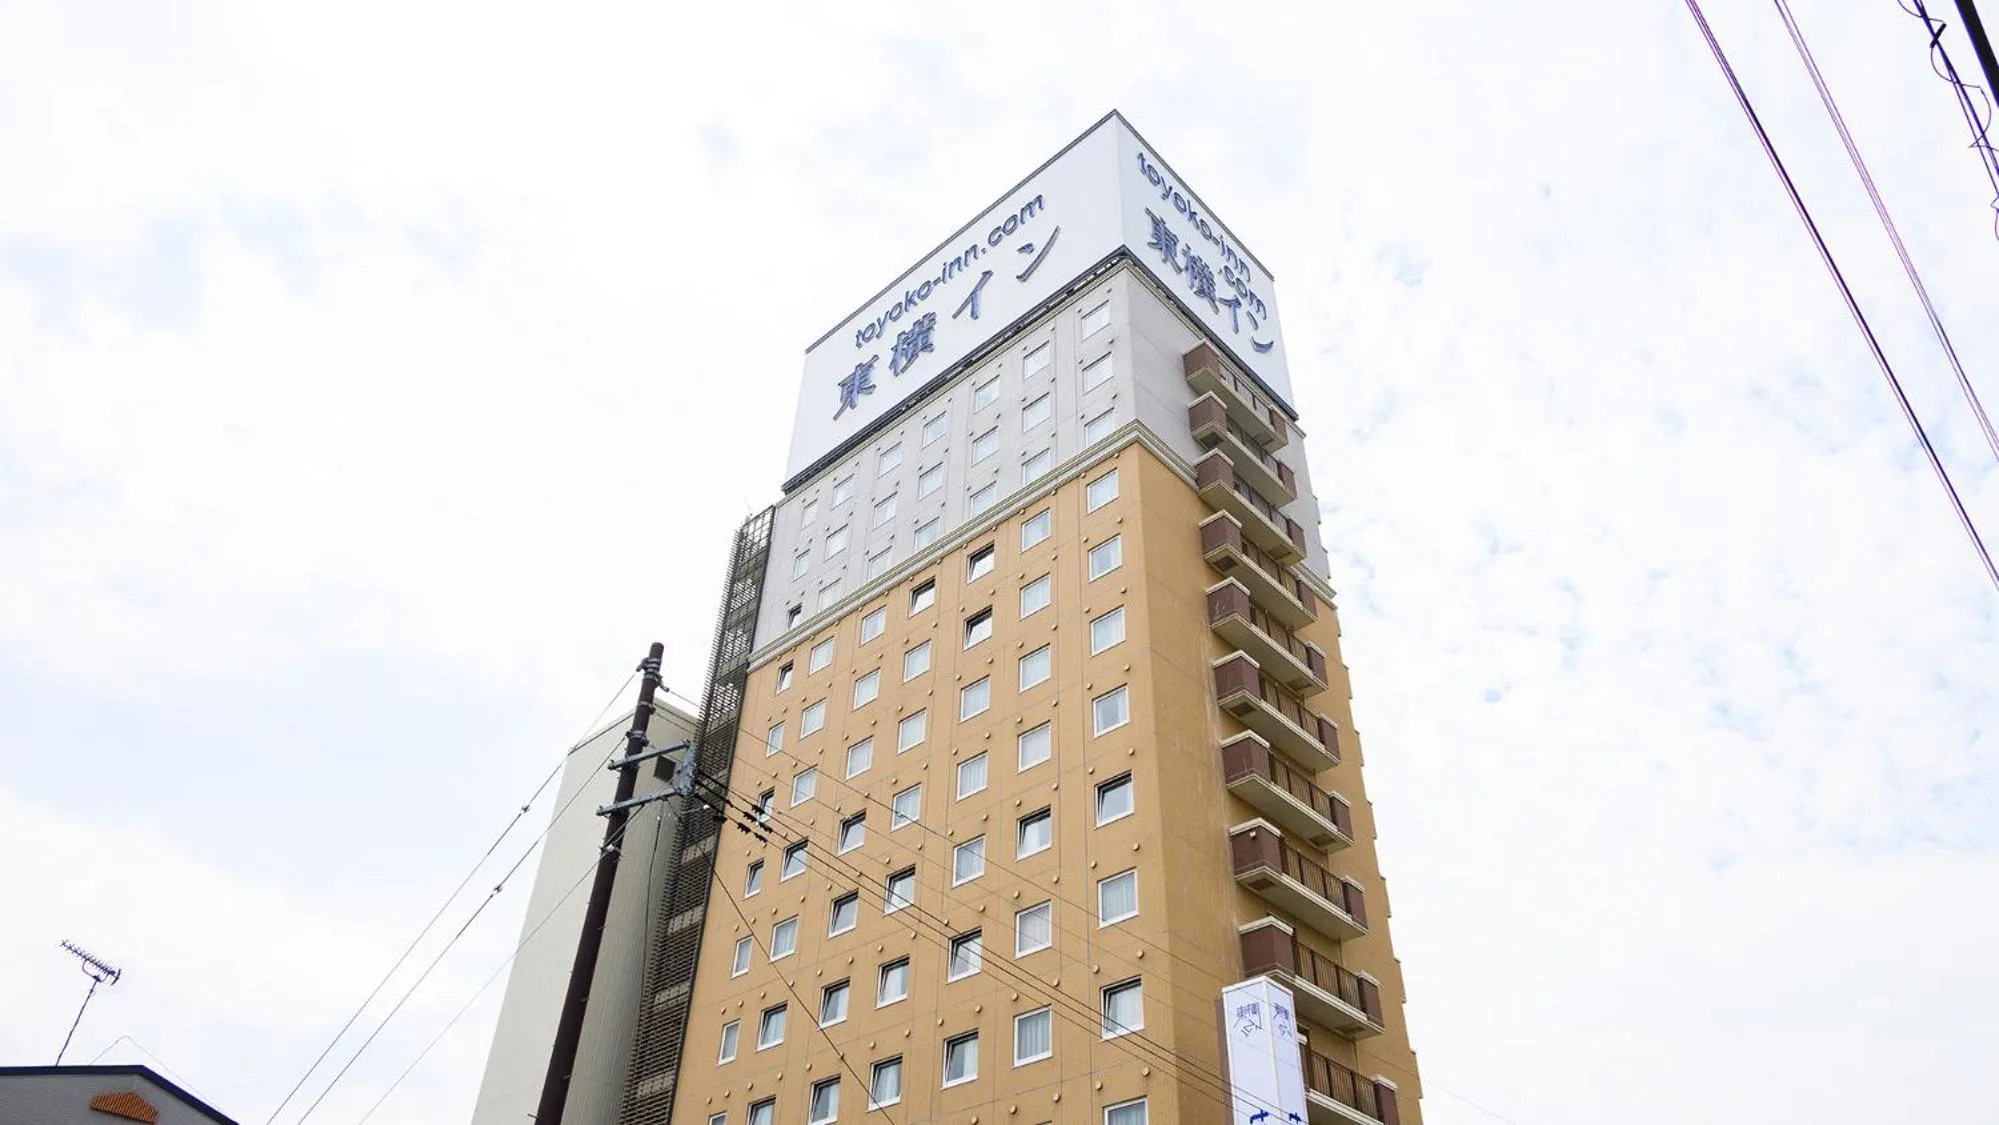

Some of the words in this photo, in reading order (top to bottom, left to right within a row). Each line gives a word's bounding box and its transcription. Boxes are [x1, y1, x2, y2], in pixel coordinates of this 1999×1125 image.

[833, 225, 1061, 421] 東横イン
[855, 194, 1044, 349] toyoko-inn.com
[1144, 206, 1275, 354] 東横イン
